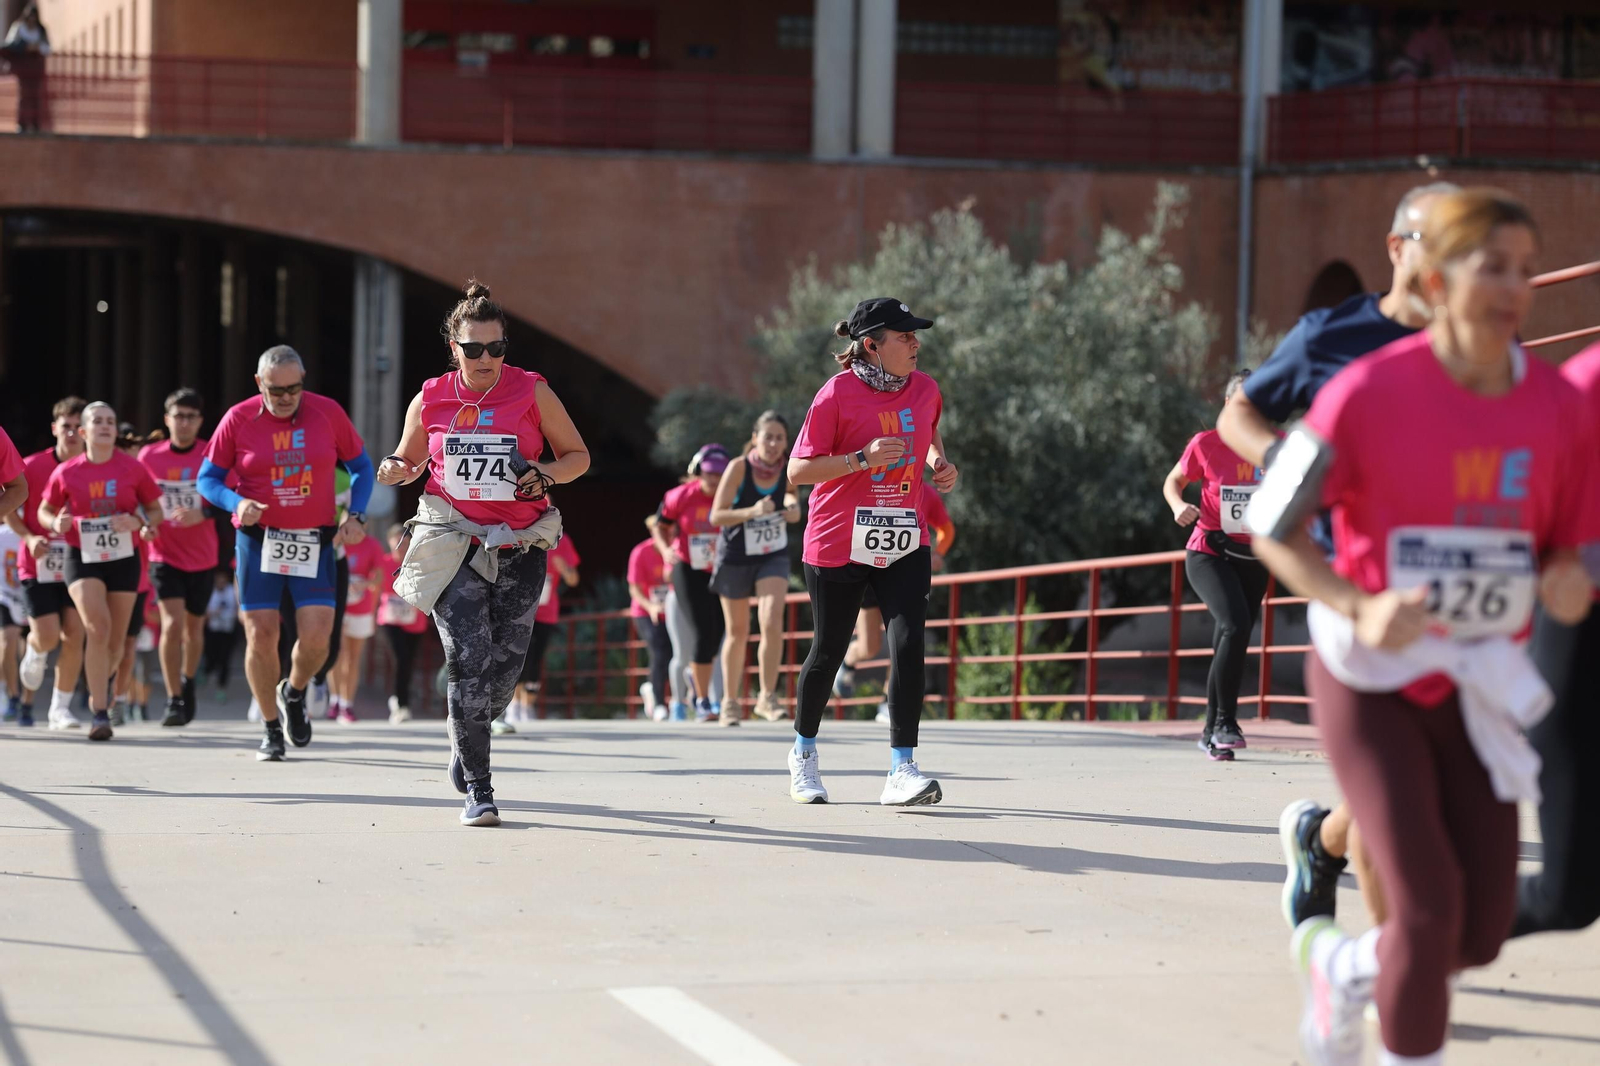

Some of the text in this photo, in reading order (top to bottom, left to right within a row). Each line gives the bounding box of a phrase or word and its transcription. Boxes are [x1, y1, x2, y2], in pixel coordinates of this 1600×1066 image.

[457, 408, 494, 427] WE
[878, 408, 915, 435] WE
[272, 428, 305, 451] WE
[447, 445, 479, 454] UMA
[271, 465, 313, 487] UMA
[456, 458, 506, 481] 474
[1454, 448, 1532, 500] WE
[89, 479, 117, 499] WE
[468, 490, 481, 498] WE
[1223, 493, 1247, 501] UMA
[859, 516, 889, 526] UMA
[96, 533, 119, 547] 46
[269, 530, 293, 541] UMA
[753, 526, 781, 544] 703
[864, 529, 912, 551] 630
[272, 542, 311, 562] 393
[875, 558, 887, 566] WE
